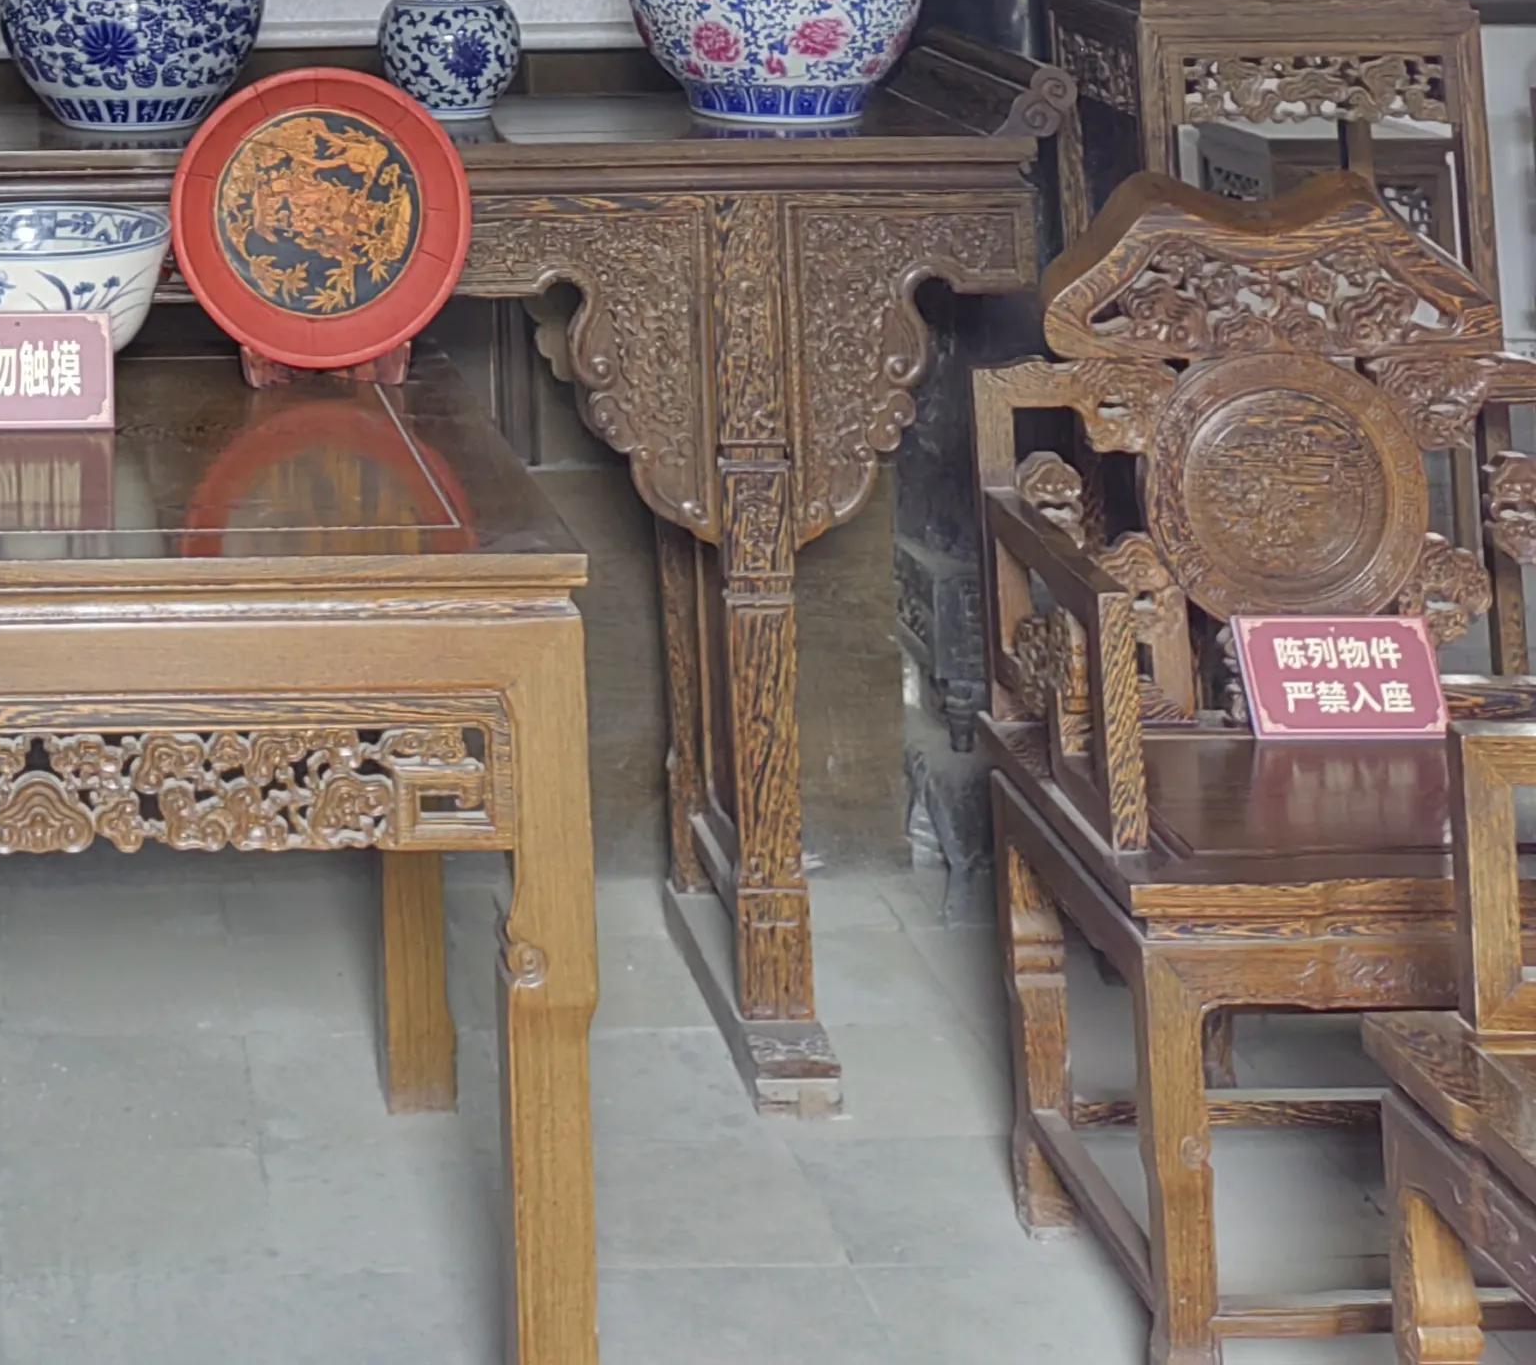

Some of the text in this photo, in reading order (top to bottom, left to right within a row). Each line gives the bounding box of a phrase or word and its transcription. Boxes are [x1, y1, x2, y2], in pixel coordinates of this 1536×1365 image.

[1273, 636, 1402, 669] 陈列物件
[1282, 680, 1415, 714] 严禁入座
